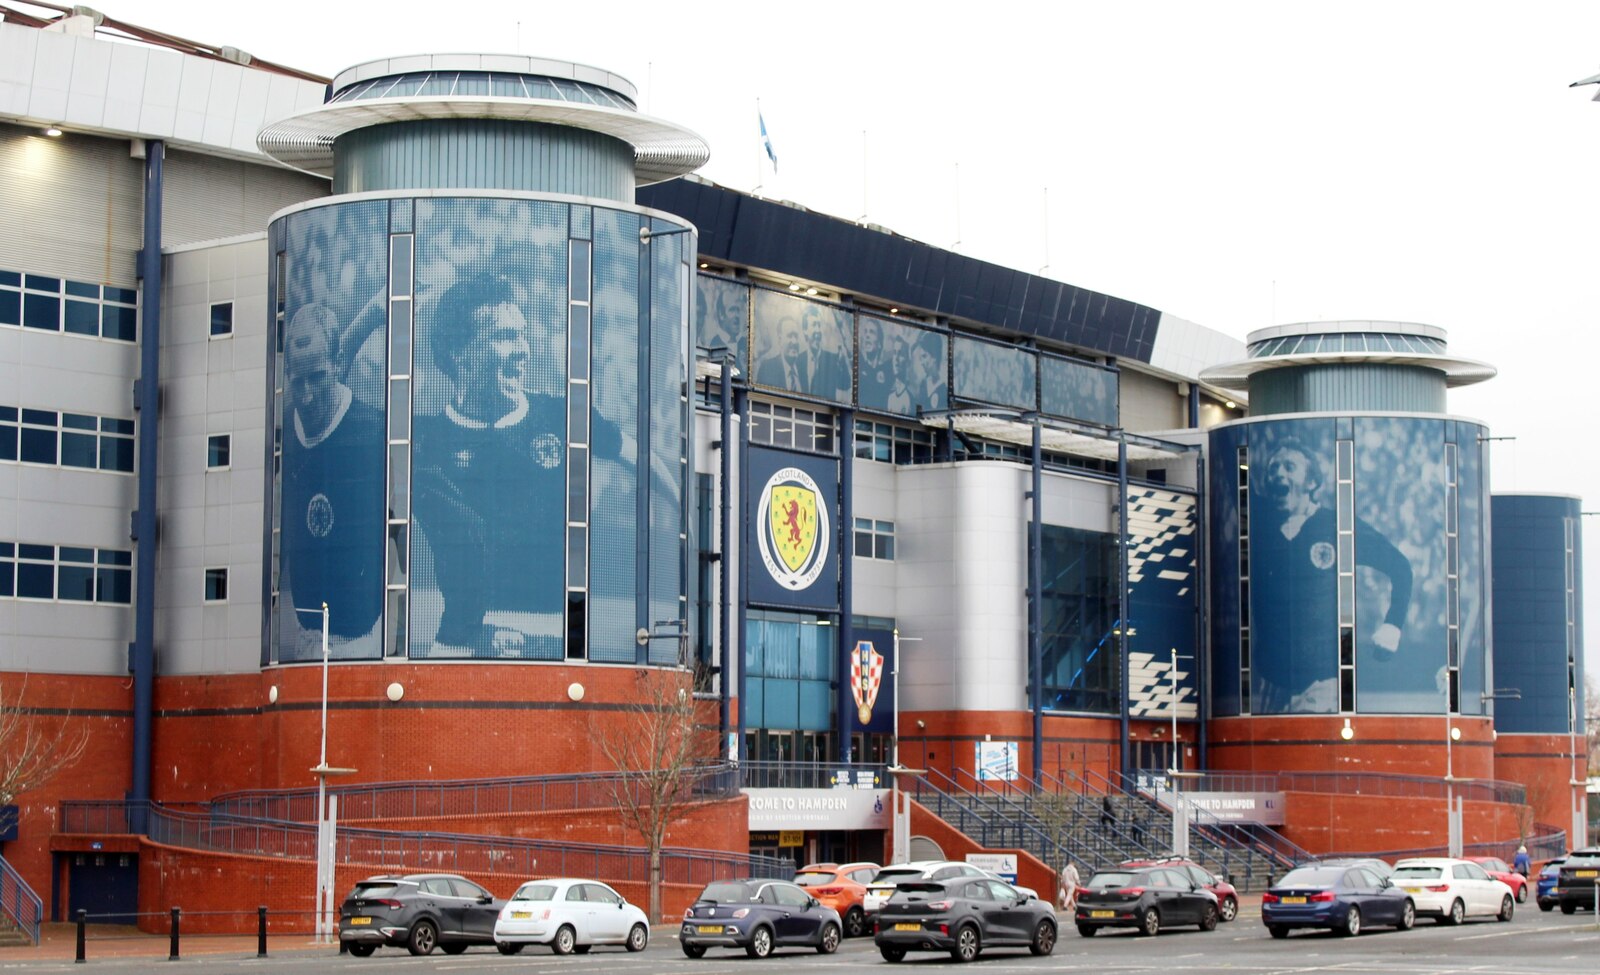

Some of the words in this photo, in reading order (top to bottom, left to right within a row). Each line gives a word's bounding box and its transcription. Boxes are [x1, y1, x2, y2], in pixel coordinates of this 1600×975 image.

[777, 469, 810, 485] SCOTLAND
[861, 650, 869, 691] HNS
[750, 797, 778, 810] COME
[782, 797, 795, 810] TO
[799, 797, 847, 810] HAMPDEN
[1177, 799, 1210, 810] WLCOME
[1211, 799, 1221, 810] TO
[1222, 799, 1256, 810] HAMPDEN
